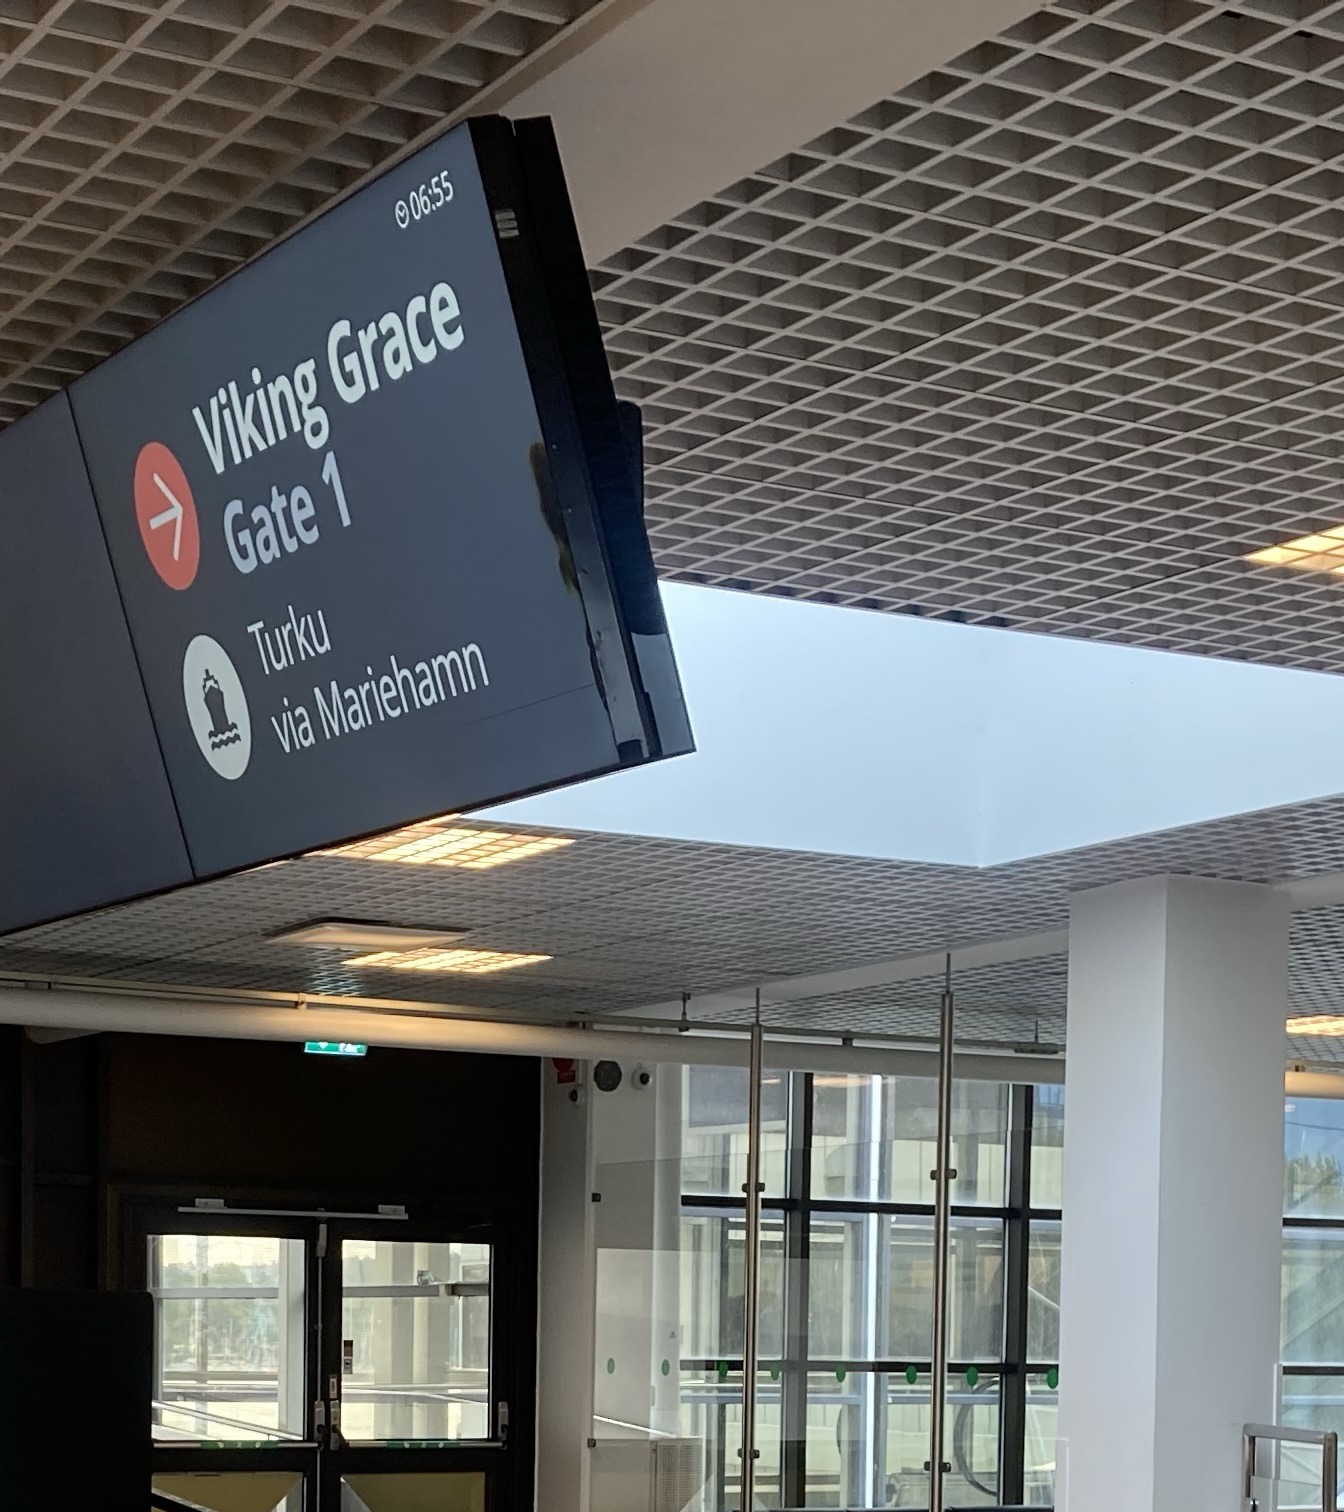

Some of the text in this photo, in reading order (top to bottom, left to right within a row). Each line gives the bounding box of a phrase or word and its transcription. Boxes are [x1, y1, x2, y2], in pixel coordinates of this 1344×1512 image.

[409, 170, 454, 220] 06:55
[192, 282, 465, 475] Viking Grace
[223, 450, 351, 574] Gate 1
[247, 604, 331, 675] Turku
[271, 643, 489, 753] via Mariehamn
